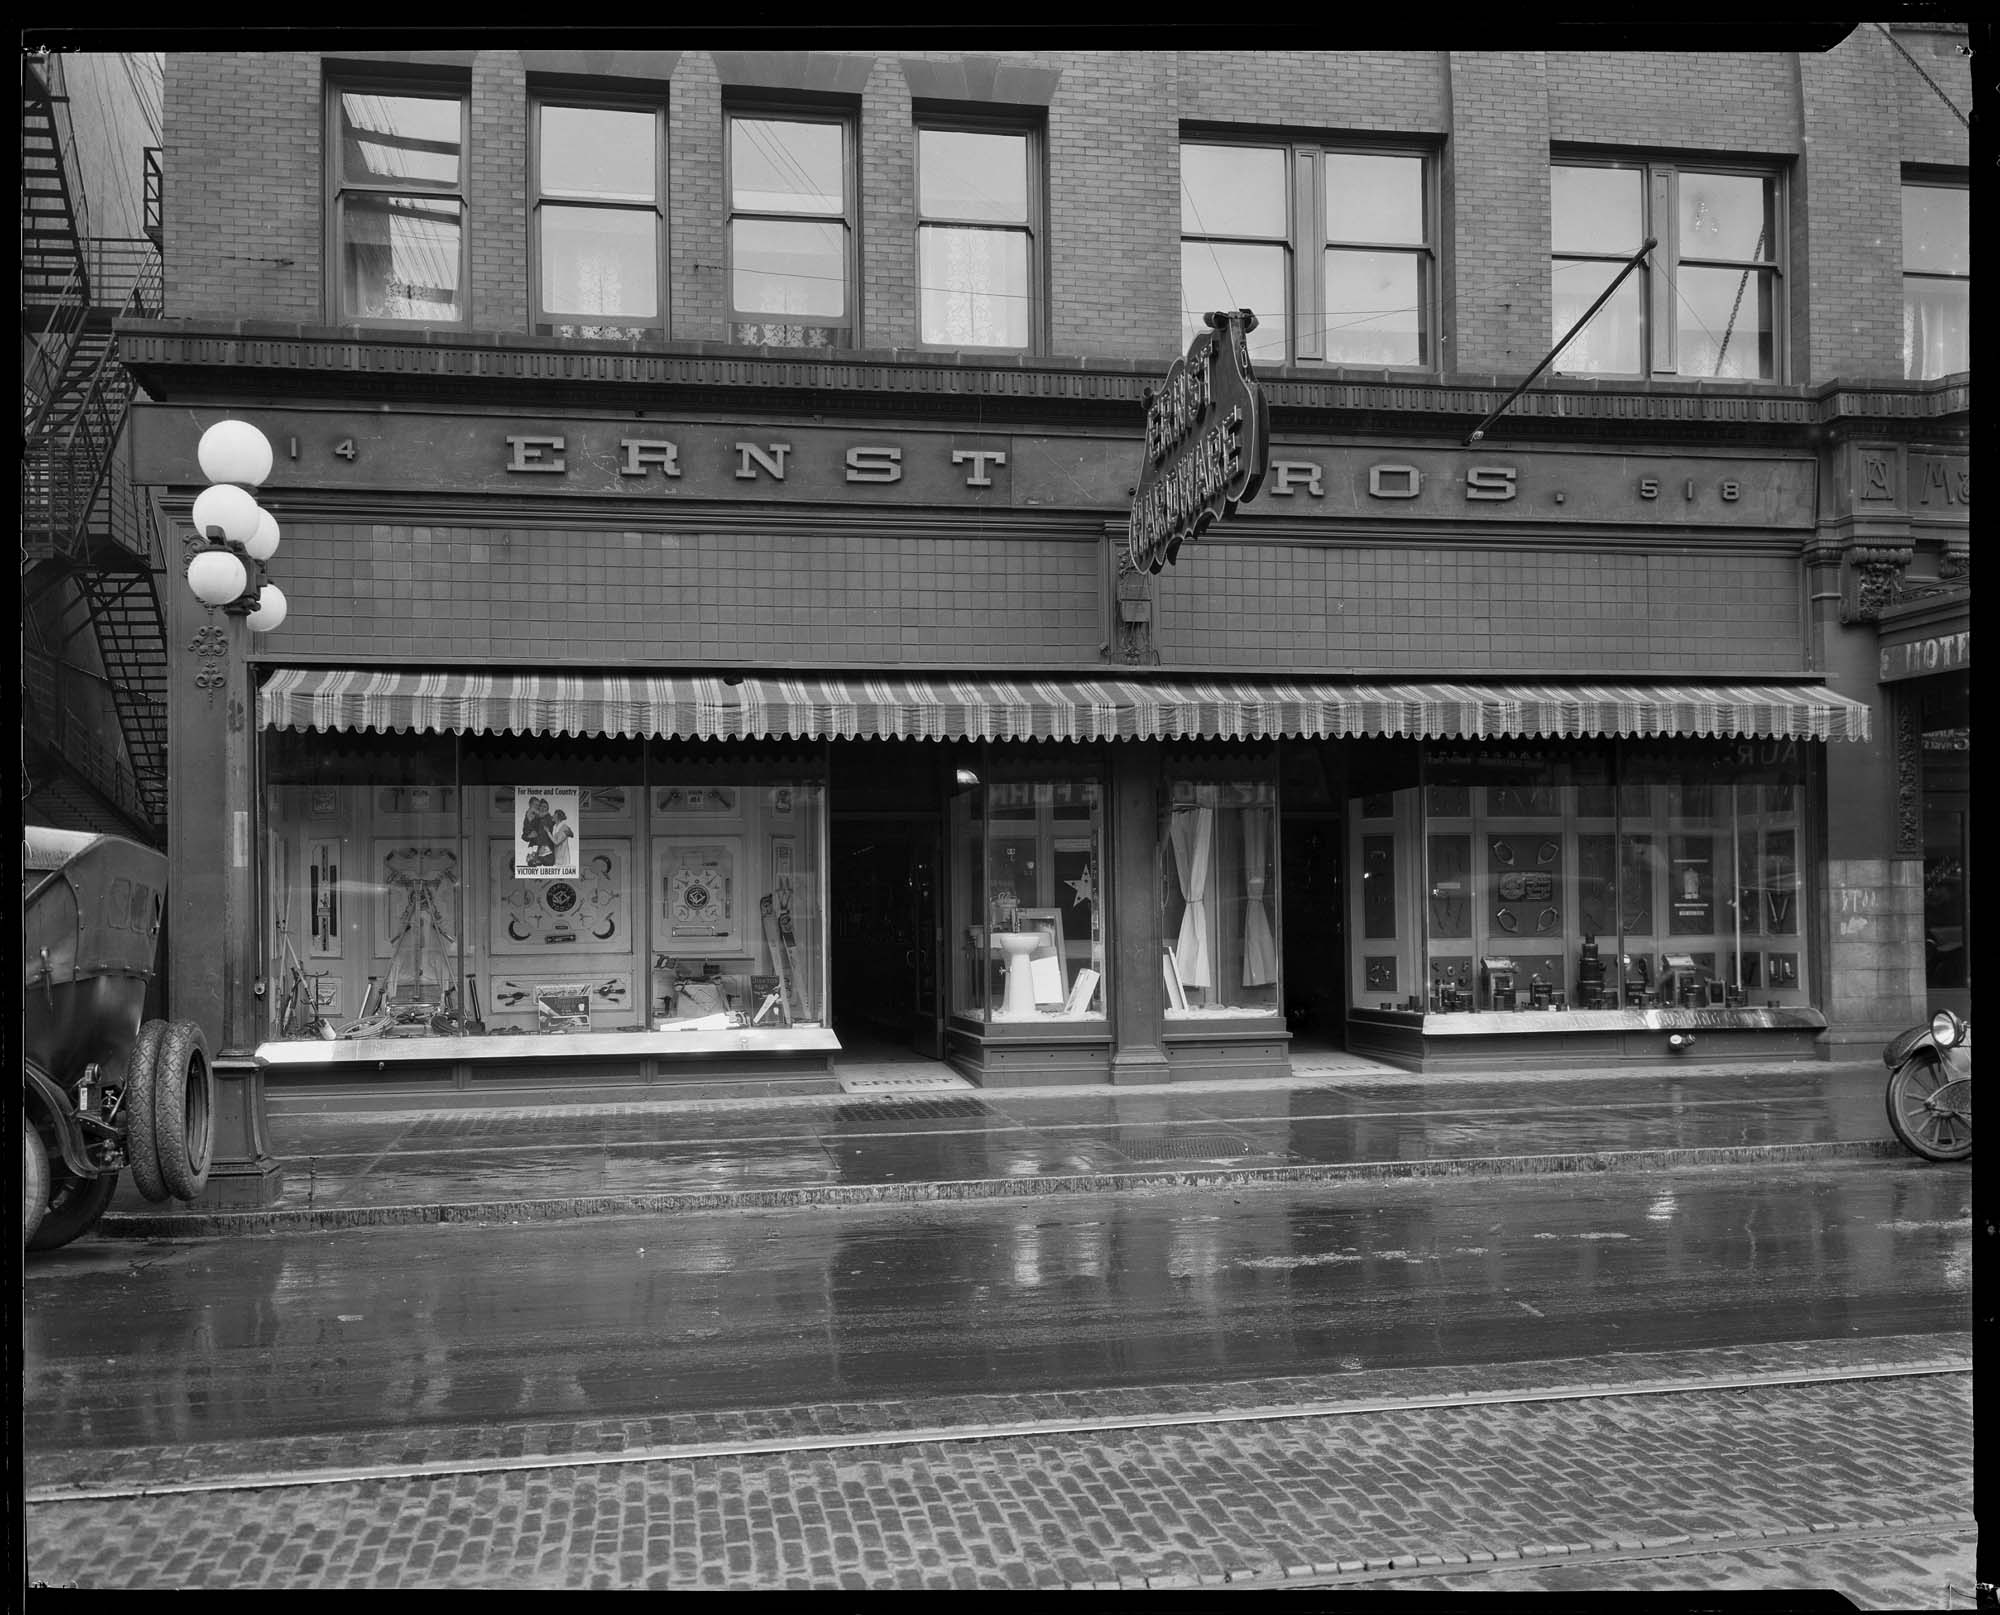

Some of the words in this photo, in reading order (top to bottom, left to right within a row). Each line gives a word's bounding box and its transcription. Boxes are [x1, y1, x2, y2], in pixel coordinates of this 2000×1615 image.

[1147, 336, 1214, 465] ERNST
[504, 434, 1007, 487] ERNST
[1270, 460, 1566, 503] ROS.
[1640, 478, 1742, 503] 518
[1131, 405, 1243, 557] HARDWARE
[555, 788, 577, 796] Country
